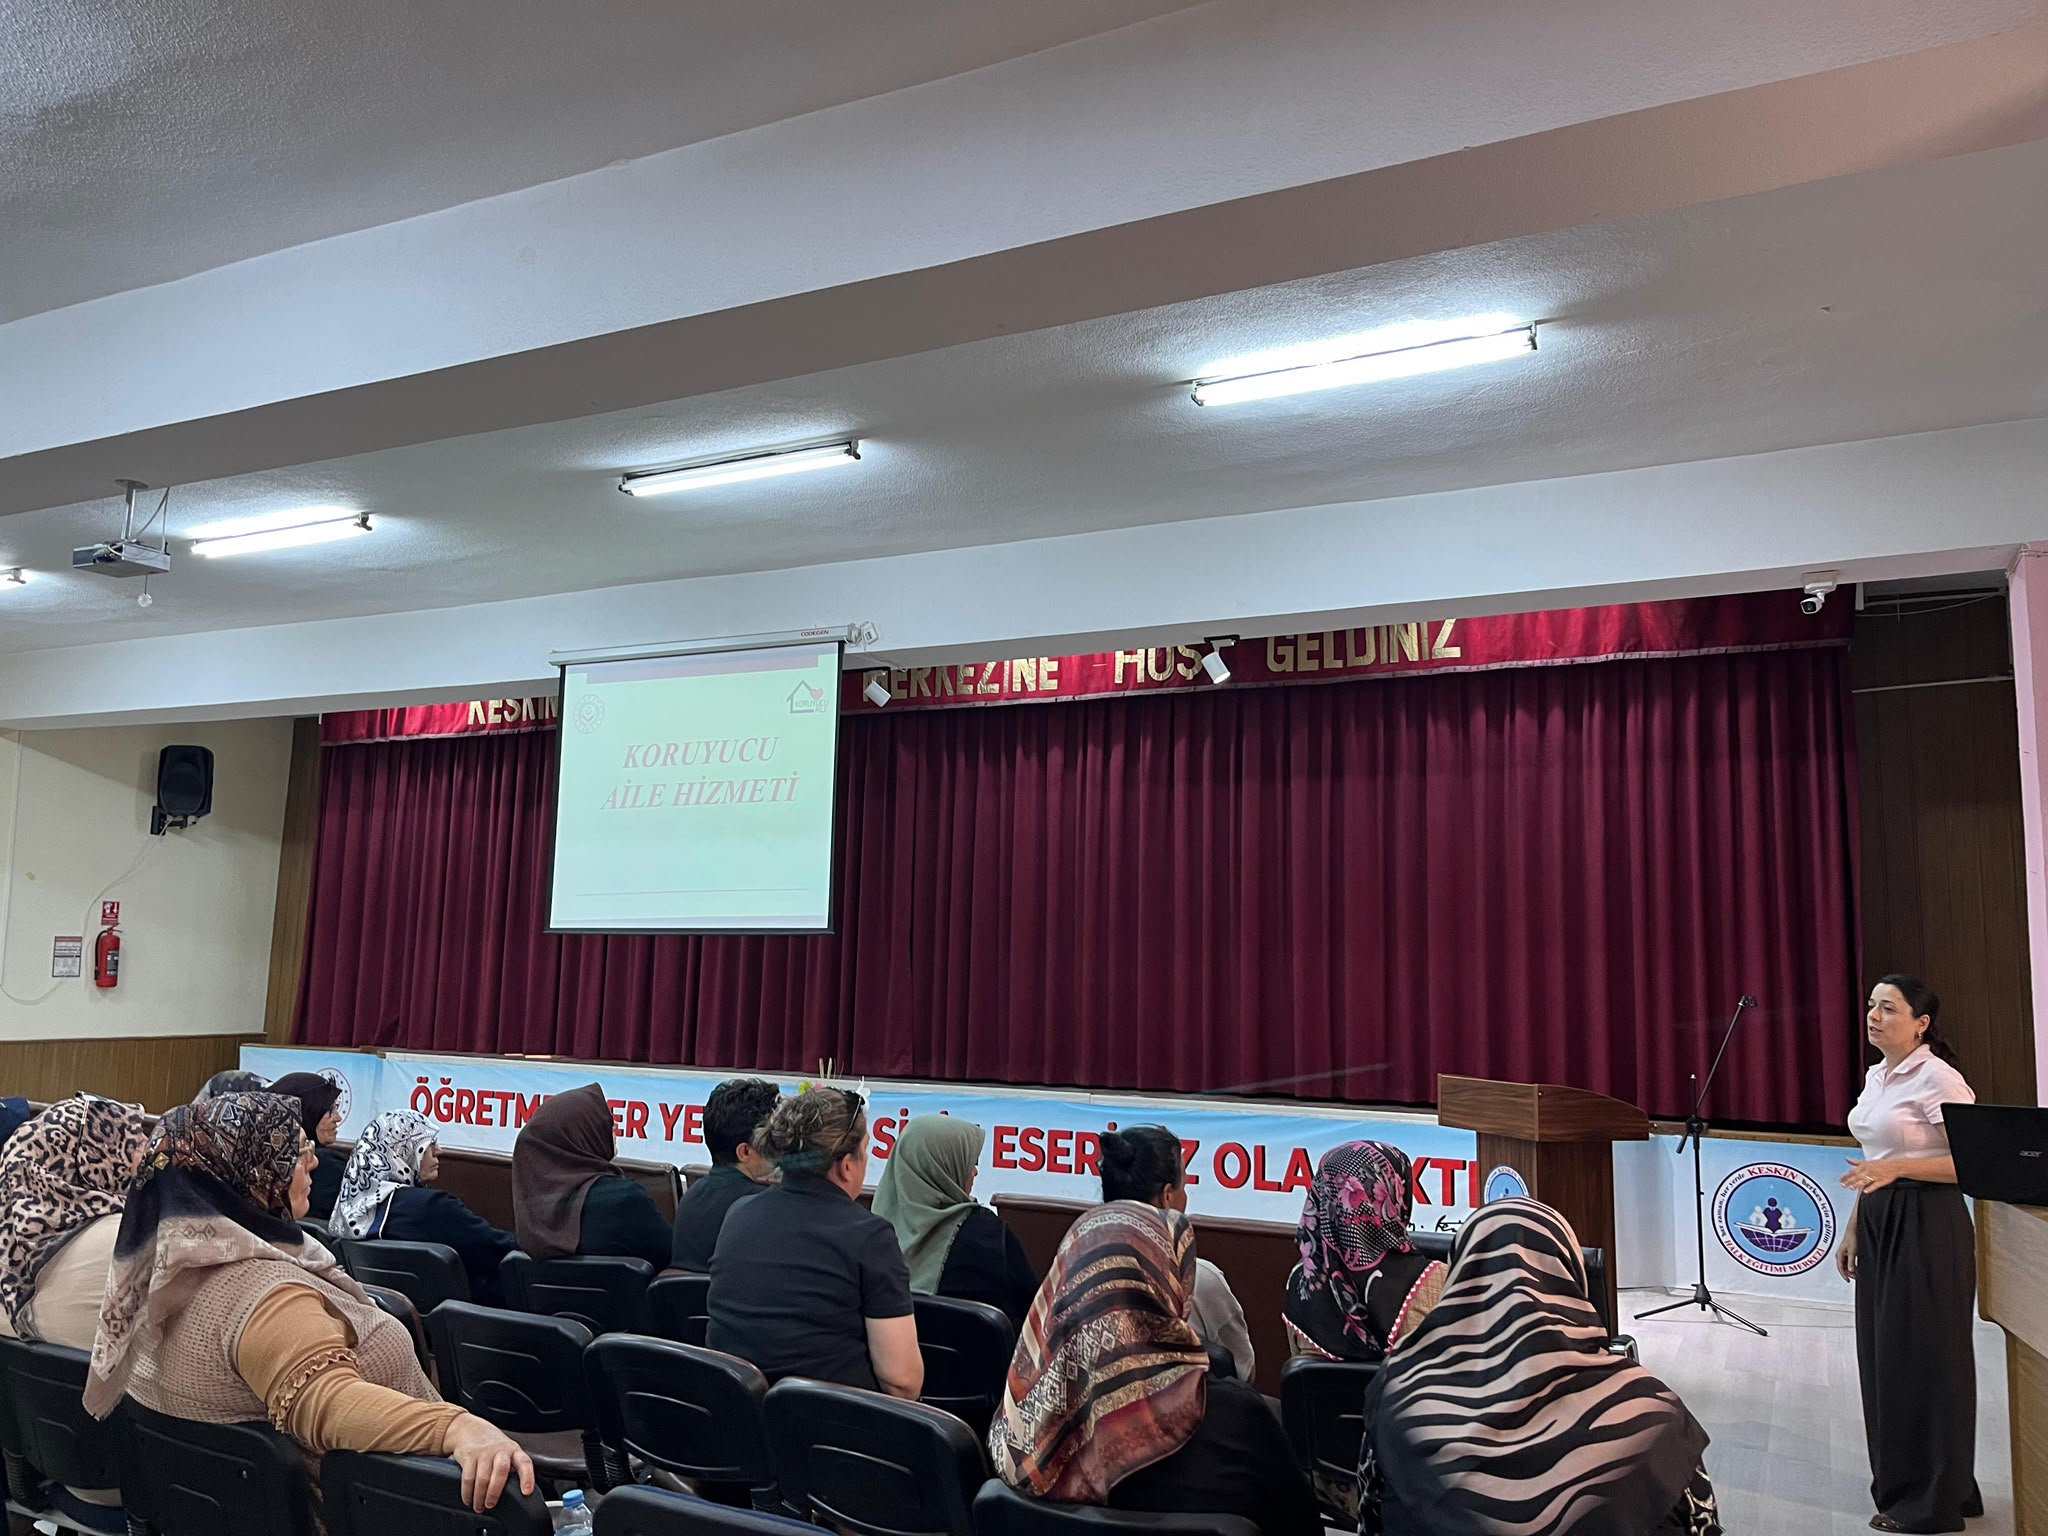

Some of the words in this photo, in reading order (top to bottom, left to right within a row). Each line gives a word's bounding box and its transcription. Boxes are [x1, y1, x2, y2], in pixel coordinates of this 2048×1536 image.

[801, 629, 829, 637] CODEGEN
[622, 736, 780, 769] KORUYUCU
[600, 779, 666, 810] AİLE
[672, 770, 800, 807] HİZMETİ
[411, 1076, 650, 1139] ÖĞRETMER
[659, 1103, 704, 1143] YE
[992, 1122, 1200, 1184] ESERZ
[2019, 1150, 2042, 1158] acer
[1747, 1166, 1798, 1180] KESKİN
[1802, 1179, 1823, 1201] herkes
[1724, 1240, 1746, 1260] HALK
